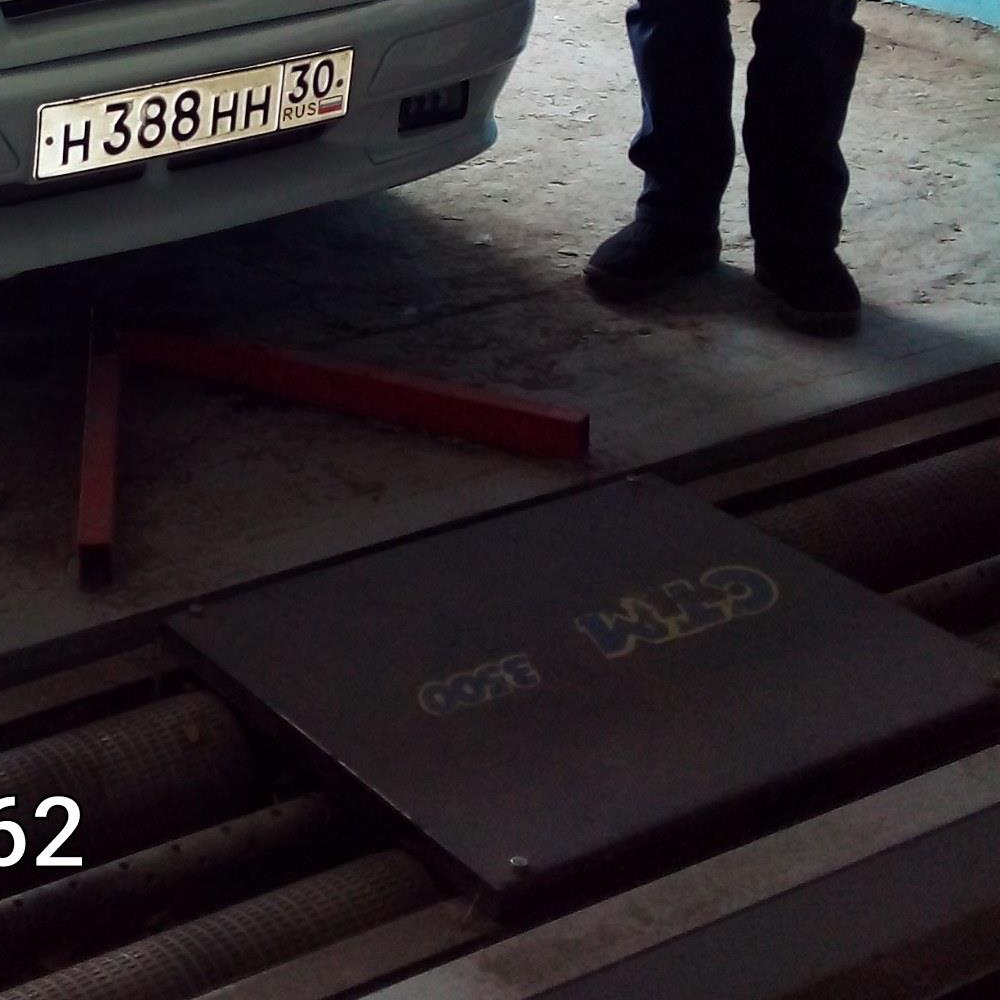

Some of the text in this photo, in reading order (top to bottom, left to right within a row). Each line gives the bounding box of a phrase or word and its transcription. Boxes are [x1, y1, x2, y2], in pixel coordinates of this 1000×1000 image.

[287, 59, 335, 104] 30
[61, 86, 271, 166] Н388НН
[282, 103, 317, 122] RUS
